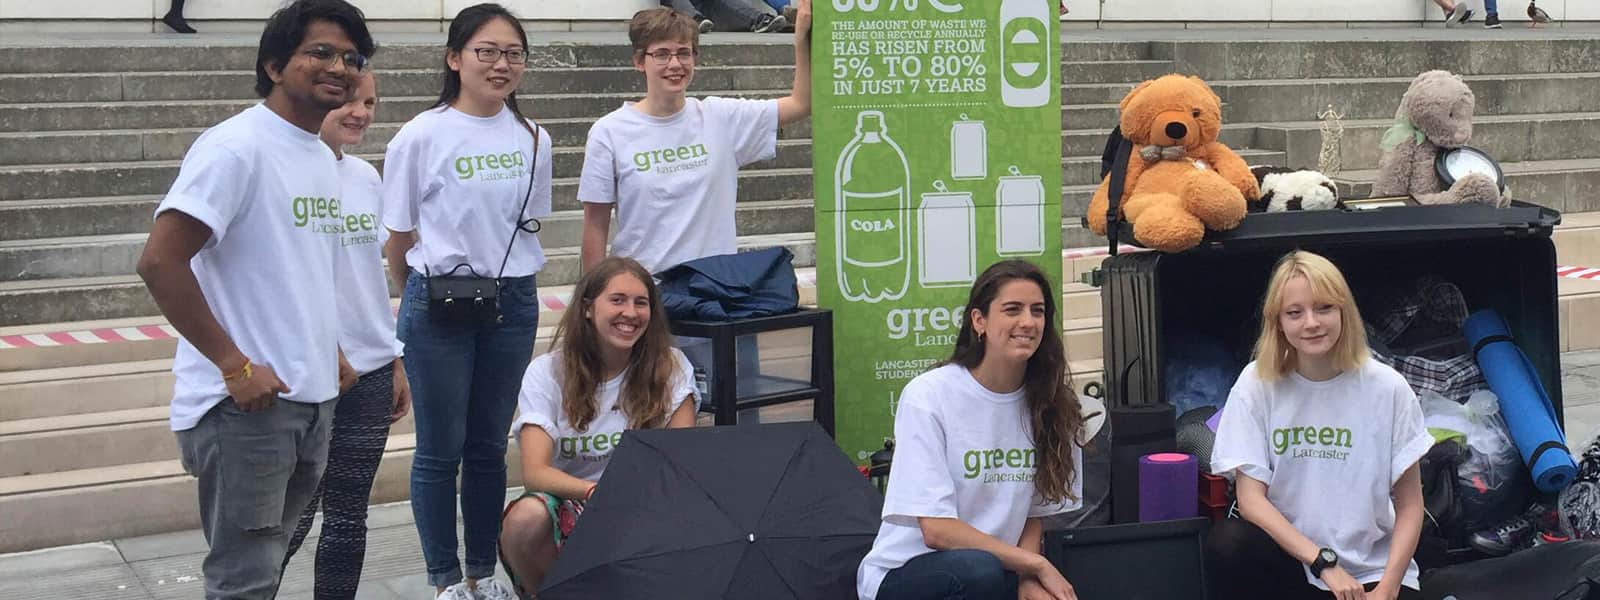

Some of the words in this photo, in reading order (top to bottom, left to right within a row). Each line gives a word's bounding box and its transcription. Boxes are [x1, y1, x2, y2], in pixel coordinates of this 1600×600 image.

[832, 21, 855, 31] THE
[858, 20, 907, 30] AMOUNT
[911, 20, 927, 30] OF
[929, 19, 967, 29] WASTE
[969, 19, 987, 28] WE
[832, 31, 868, 40] RE-USE
[871, 31, 885, 40] OR
[887, 30, 932, 39] RECYCLE
[934, 29, 986, 39] ANNUALLY
[832, 41, 870, 56] HAS
[874, 40, 929, 55] RISEN
[934, 39, 985, 54] FROM
[833, 57, 874, 79] 5%
[883, 56, 922, 78] TO
[930, 55, 986, 77] 80%
[834, 81, 852, 95] IN
[858, 80, 904, 95] JUST
[910, 80, 919, 94] 7
[925, 78, 986, 93] YEARS
[455, 151, 523, 180] green
[633, 143, 708, 172] green
[293, 196, 343, 227] gree
[851, 218, 896, 232] COLA
[886, 306, 965, 339] gree
[915, 332, 958, 347] Lanc
[560, 432, 622, 460] gree
[1273, 425, 1352, 455] green
[964, 448, 1040, 479] green
